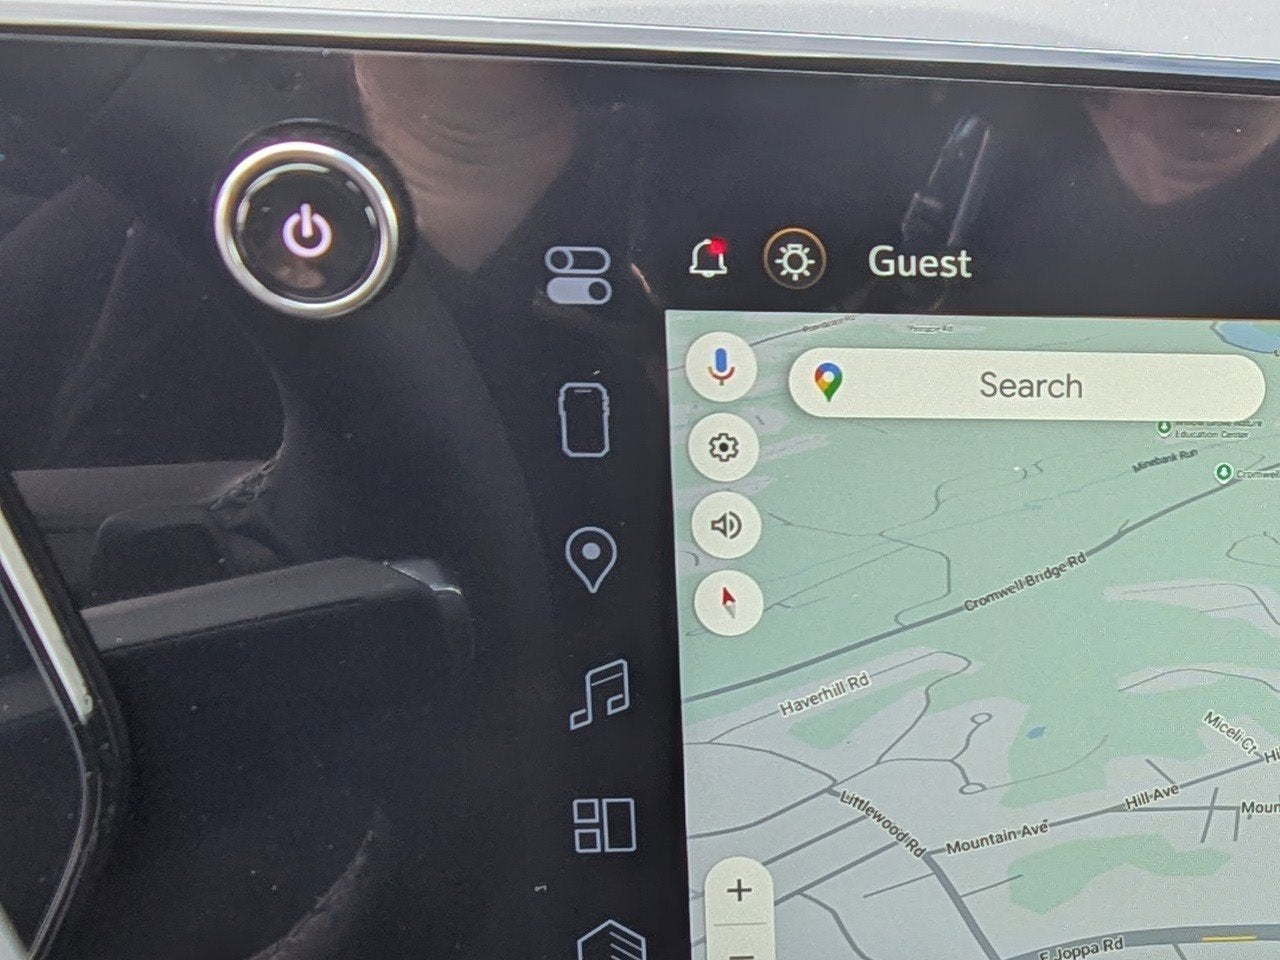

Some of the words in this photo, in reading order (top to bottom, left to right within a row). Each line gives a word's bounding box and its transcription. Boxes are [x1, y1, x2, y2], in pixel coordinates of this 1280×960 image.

[868, 245, 972, 278] Guest
[980, 371, 1082, 398] Search
[1175, 430, 1218, 438] Education
[1132, 452, 1178, 473] Minebank
[1179, 449, 1199, 459] Run
[1236, 470, 1280, 479] Cromwell
[964, 577, 1024, 611] Cromwell
[1025, 561, 1067, 588] Bridge
[1067, 551, 1087, 568] Rd
[779, 682, 847, 716] Haverhill
[847, 672, 870, 691] Rd
[1203, 711, 1244, 745] Miceli
[1241, 736, 1258, 755] Ct
[1125, 791, 1150, 811] Hill
[1151, 784, 1179, 801] Ave
[840, 789, 908, 843] Littlewood
[904, 837, 928, 860] Rd
[945, 827, 1018, 855] Mountain
[1021, 821, 1049, 839] Ave
[1054, 943, 1099, 960] Joppa
[1103, 937, 1124, 952] Rd
